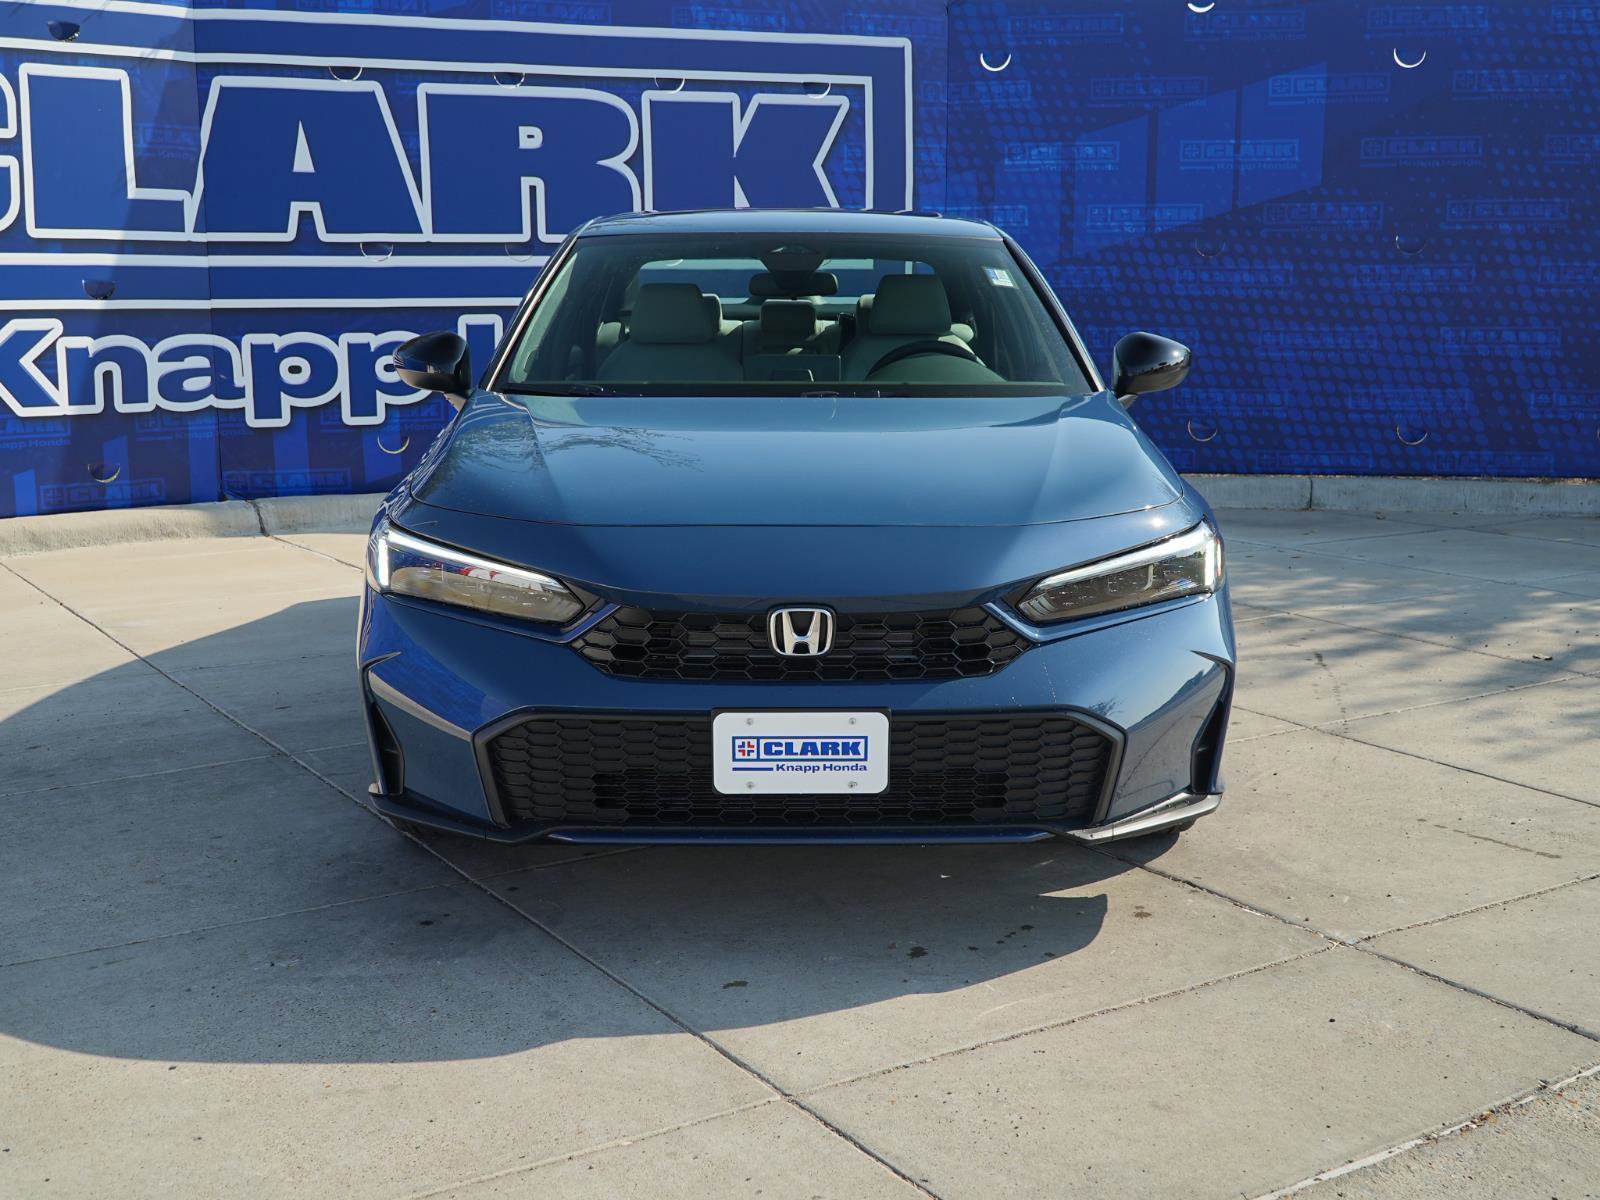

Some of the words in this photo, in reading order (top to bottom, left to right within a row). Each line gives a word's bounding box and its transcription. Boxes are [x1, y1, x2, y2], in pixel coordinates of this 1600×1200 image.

[763, 741, 862, 756] CLARK
[776, 763, 820, 774] Knapp
[823, 763, 868, 772] Honda
